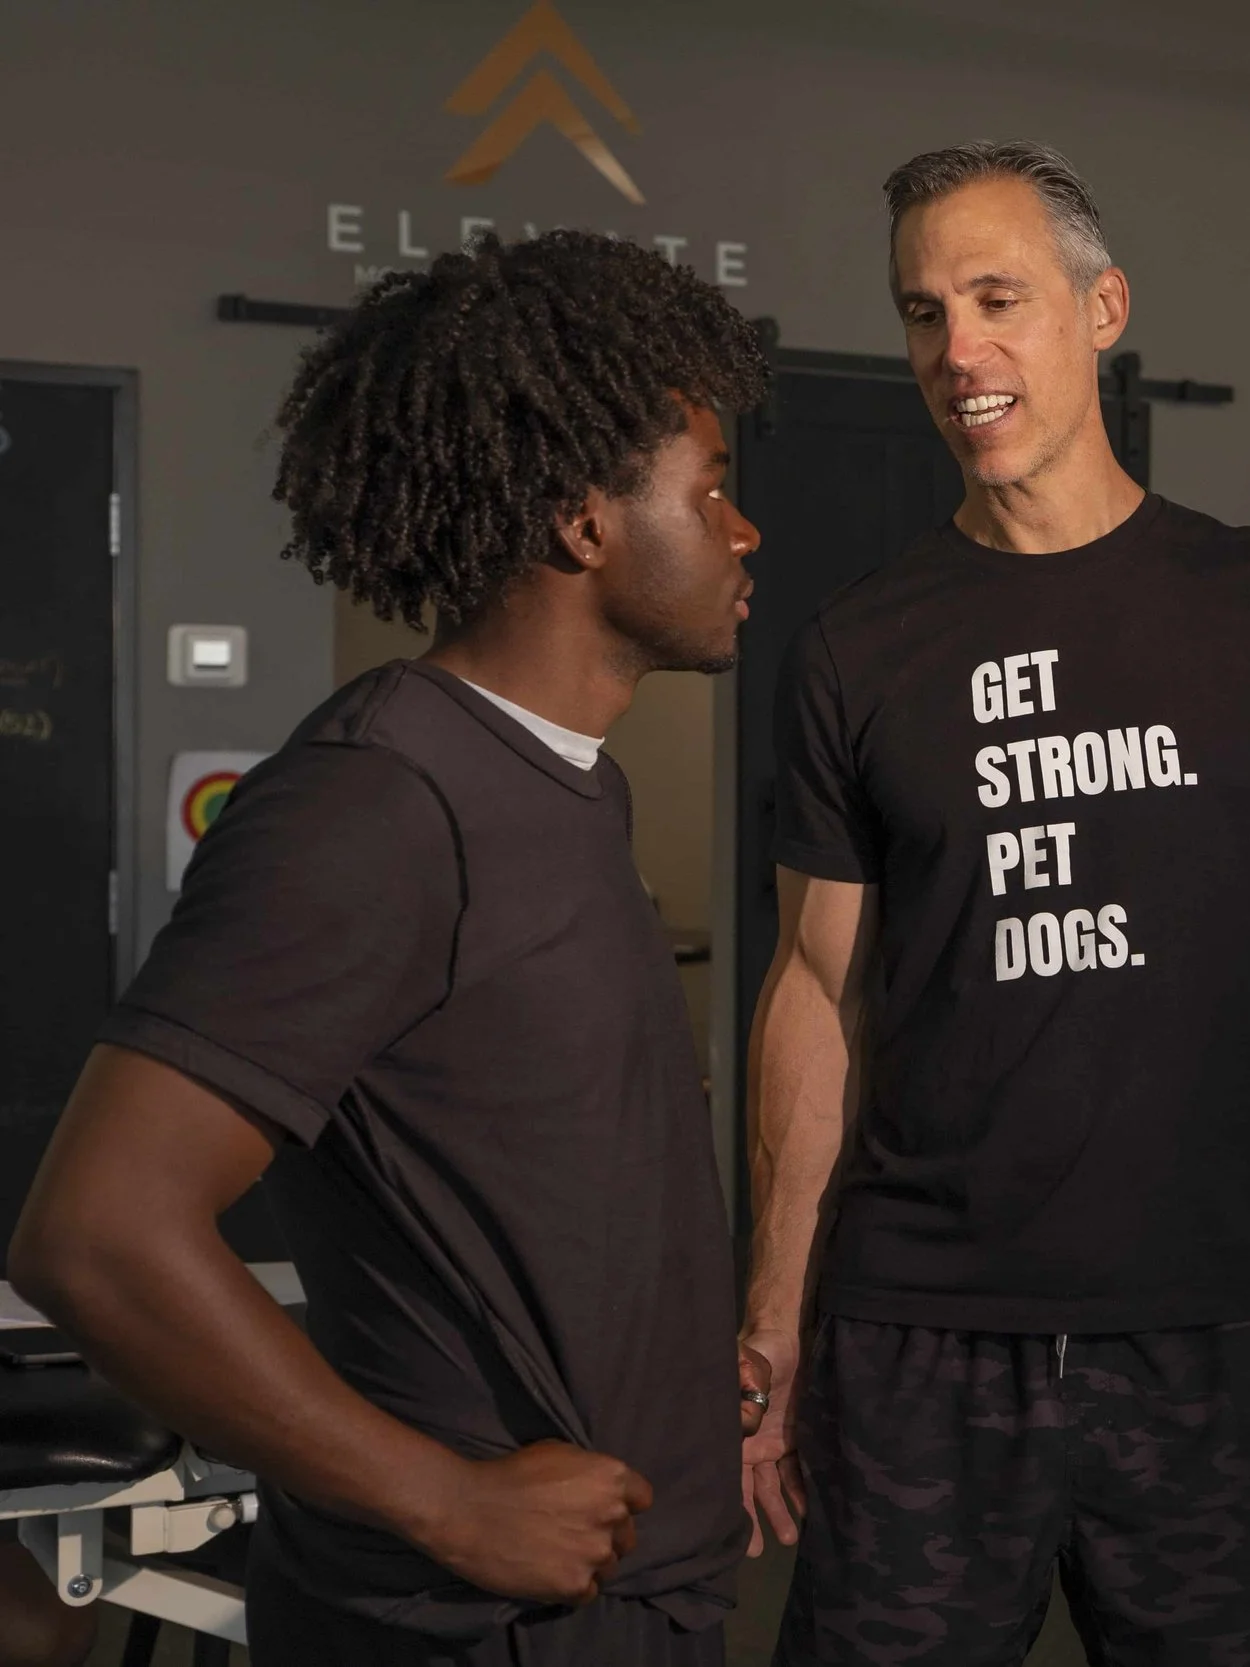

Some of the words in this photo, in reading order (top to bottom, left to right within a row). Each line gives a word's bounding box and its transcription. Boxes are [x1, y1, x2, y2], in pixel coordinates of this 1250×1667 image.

[971, 649, 1059, 724] GET
[974, 725, 1198, 809] STRONG.
[986, 822, 1076, 896] PET
[995, 903, 1145, 982] DOGS.
